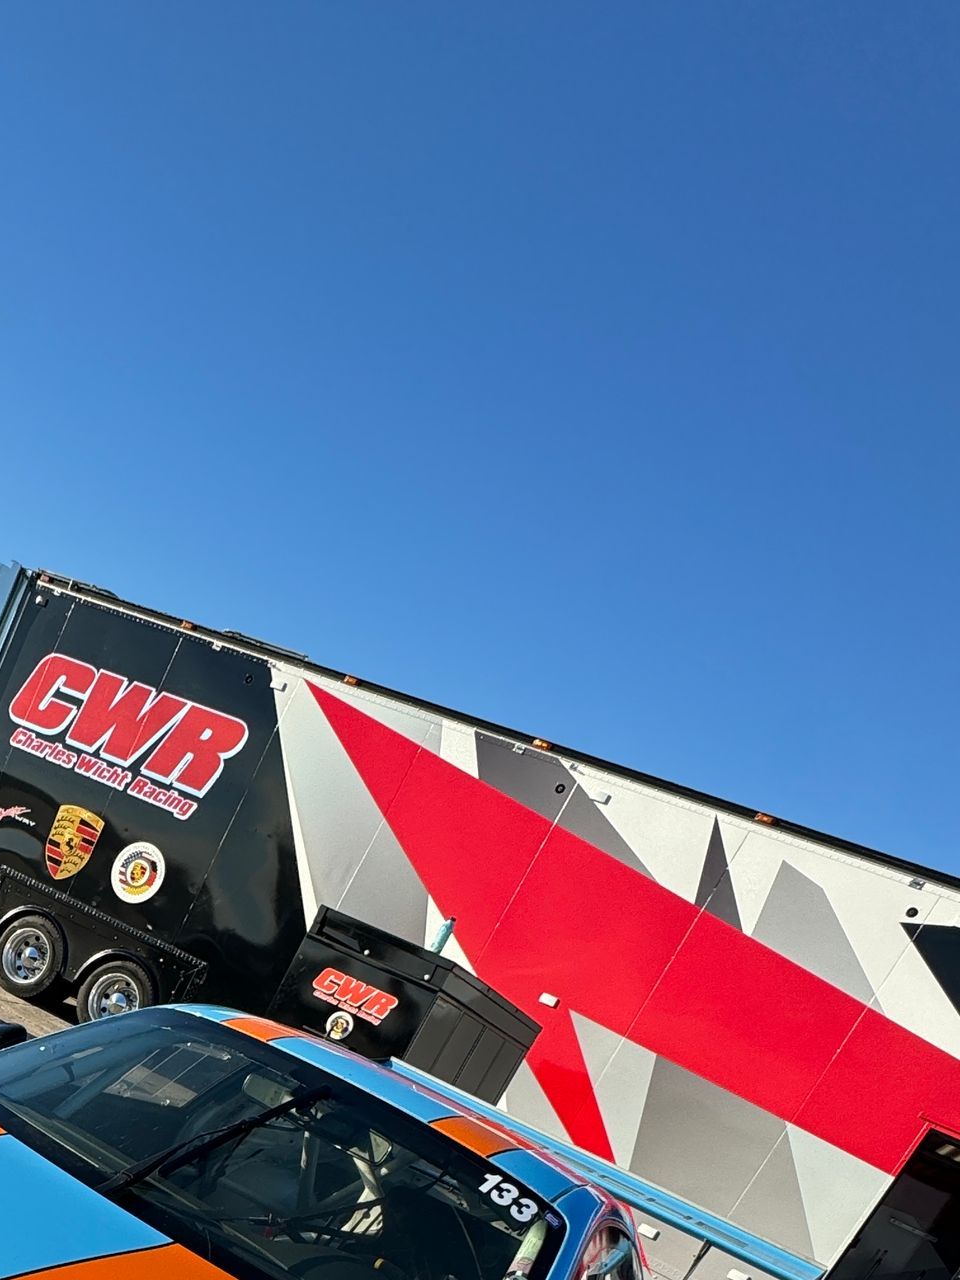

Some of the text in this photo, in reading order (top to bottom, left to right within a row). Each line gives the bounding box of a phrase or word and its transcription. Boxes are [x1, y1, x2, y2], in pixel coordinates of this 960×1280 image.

[9, 653, 249, 799] CWR
[11, 727, 77, 768] Charles
[75, 754, 131, 789] Wicht
[128, 777, 197, 821] Racing
[313, 967, 399, 1021] CWR
[478, 1173, 539, 1223] 133
